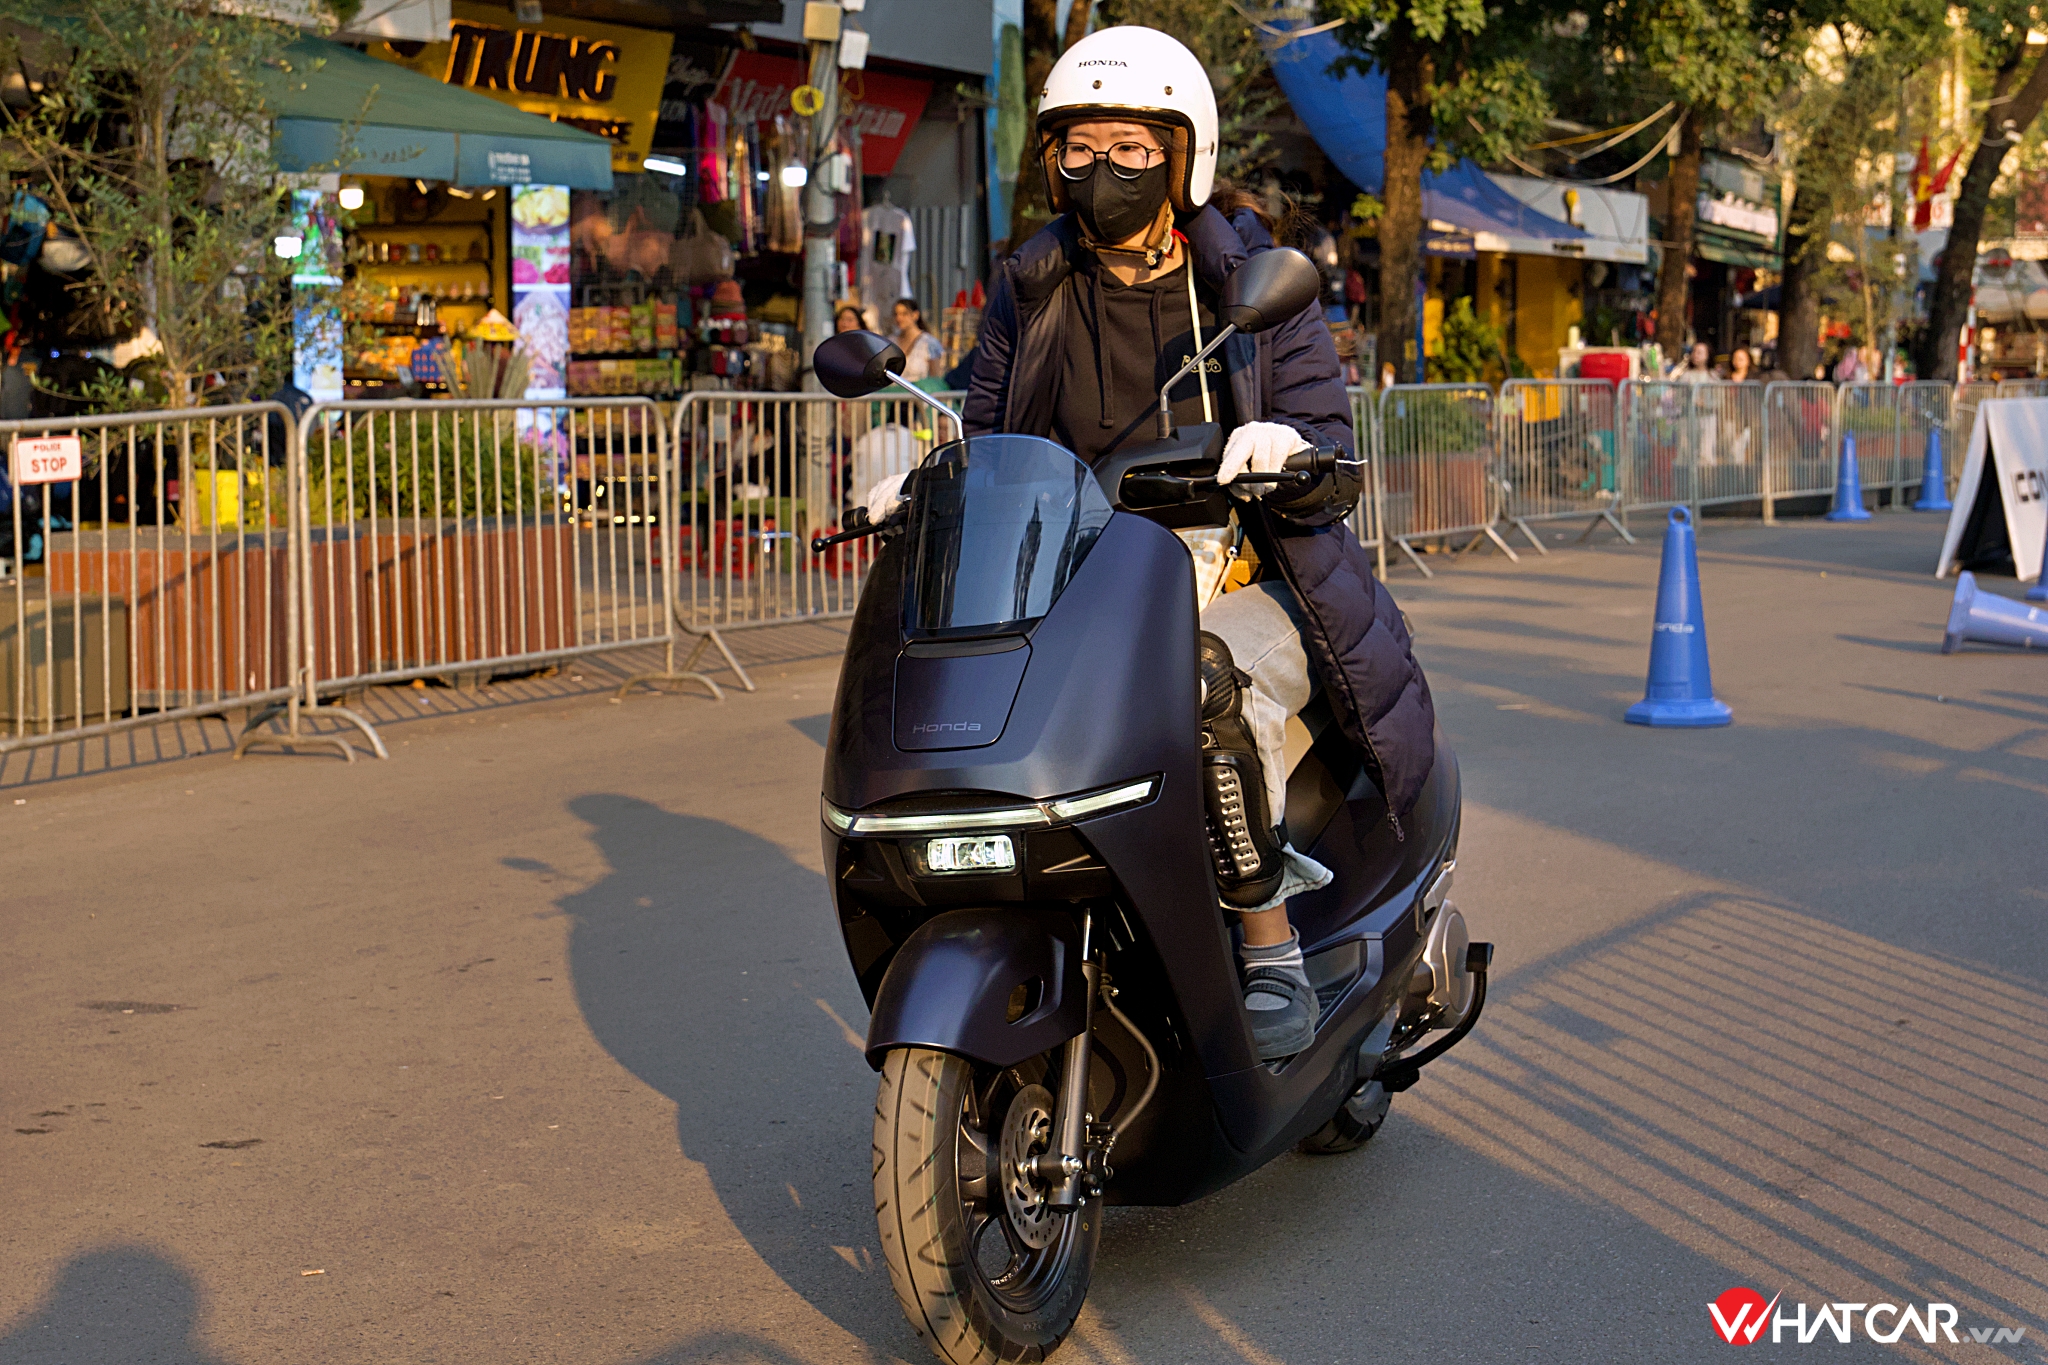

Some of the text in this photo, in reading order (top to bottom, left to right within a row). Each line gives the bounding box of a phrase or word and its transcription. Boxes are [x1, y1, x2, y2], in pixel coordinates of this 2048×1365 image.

[1078, 60, 1128, 68] HONDA
[33, 443, 61, 452] POLICE
[31, 457, 67, 473] STOP
[912, 721, 982, 734] Honda
